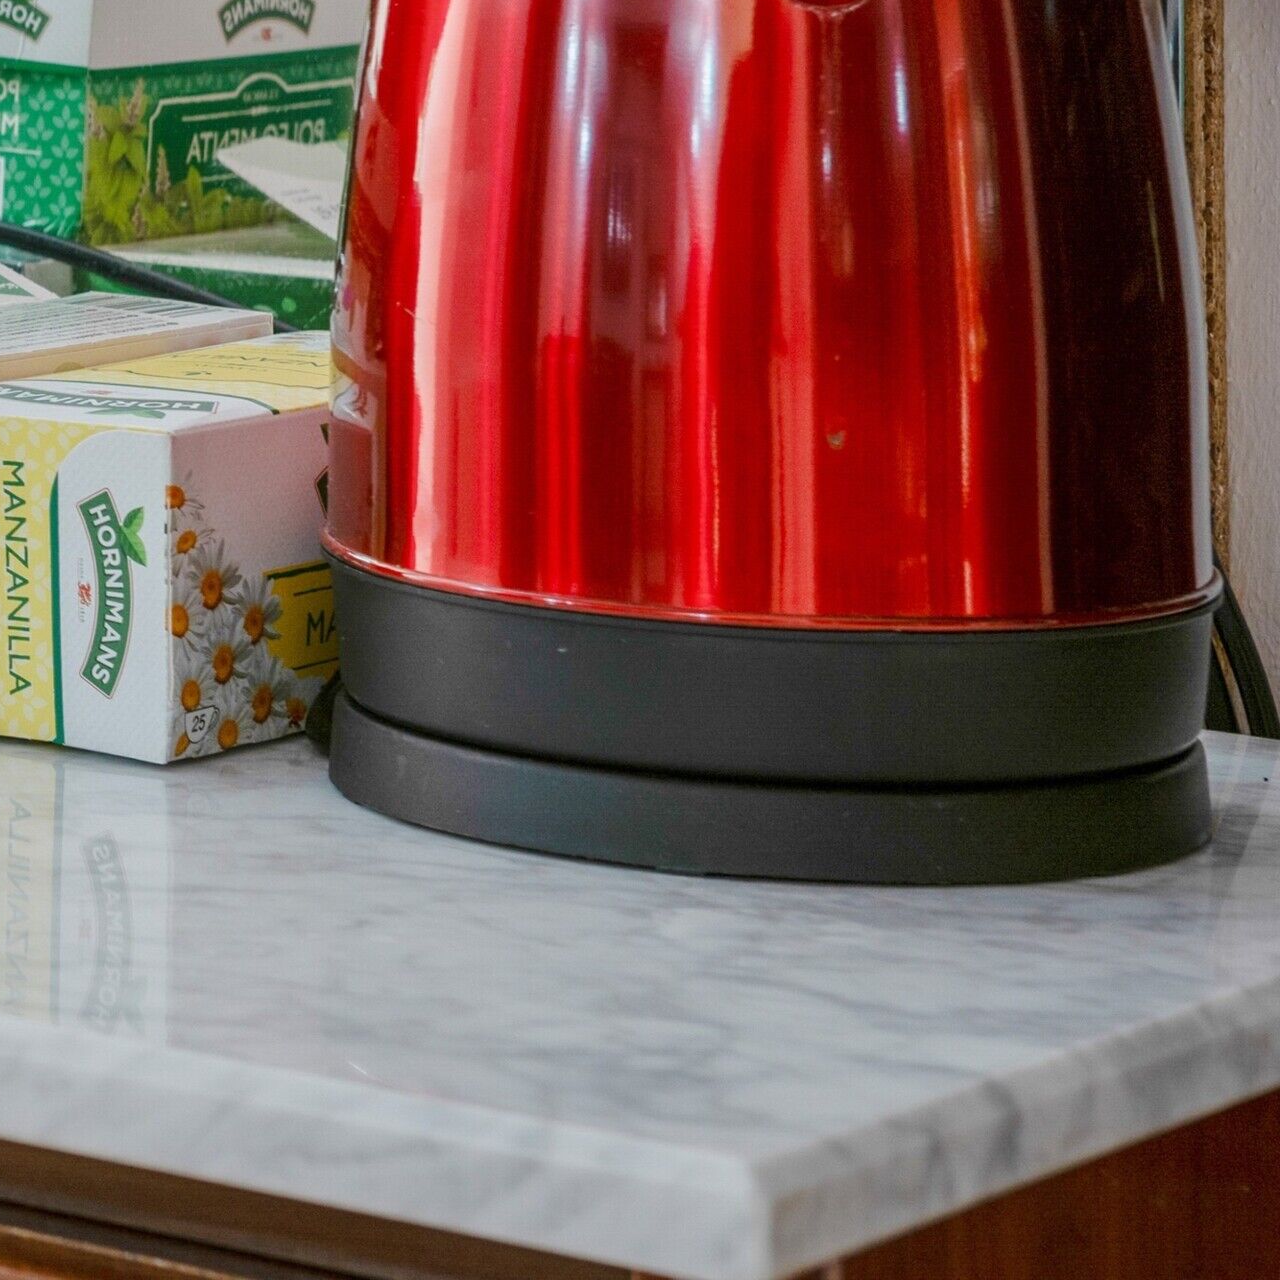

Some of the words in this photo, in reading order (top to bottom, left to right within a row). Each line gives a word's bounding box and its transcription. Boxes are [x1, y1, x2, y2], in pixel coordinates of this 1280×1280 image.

[2, 459, 32, 695] MANZANILLA
[88, 503, 124, 686] HORNIMANS
[190, 714, 208, 732] 25
